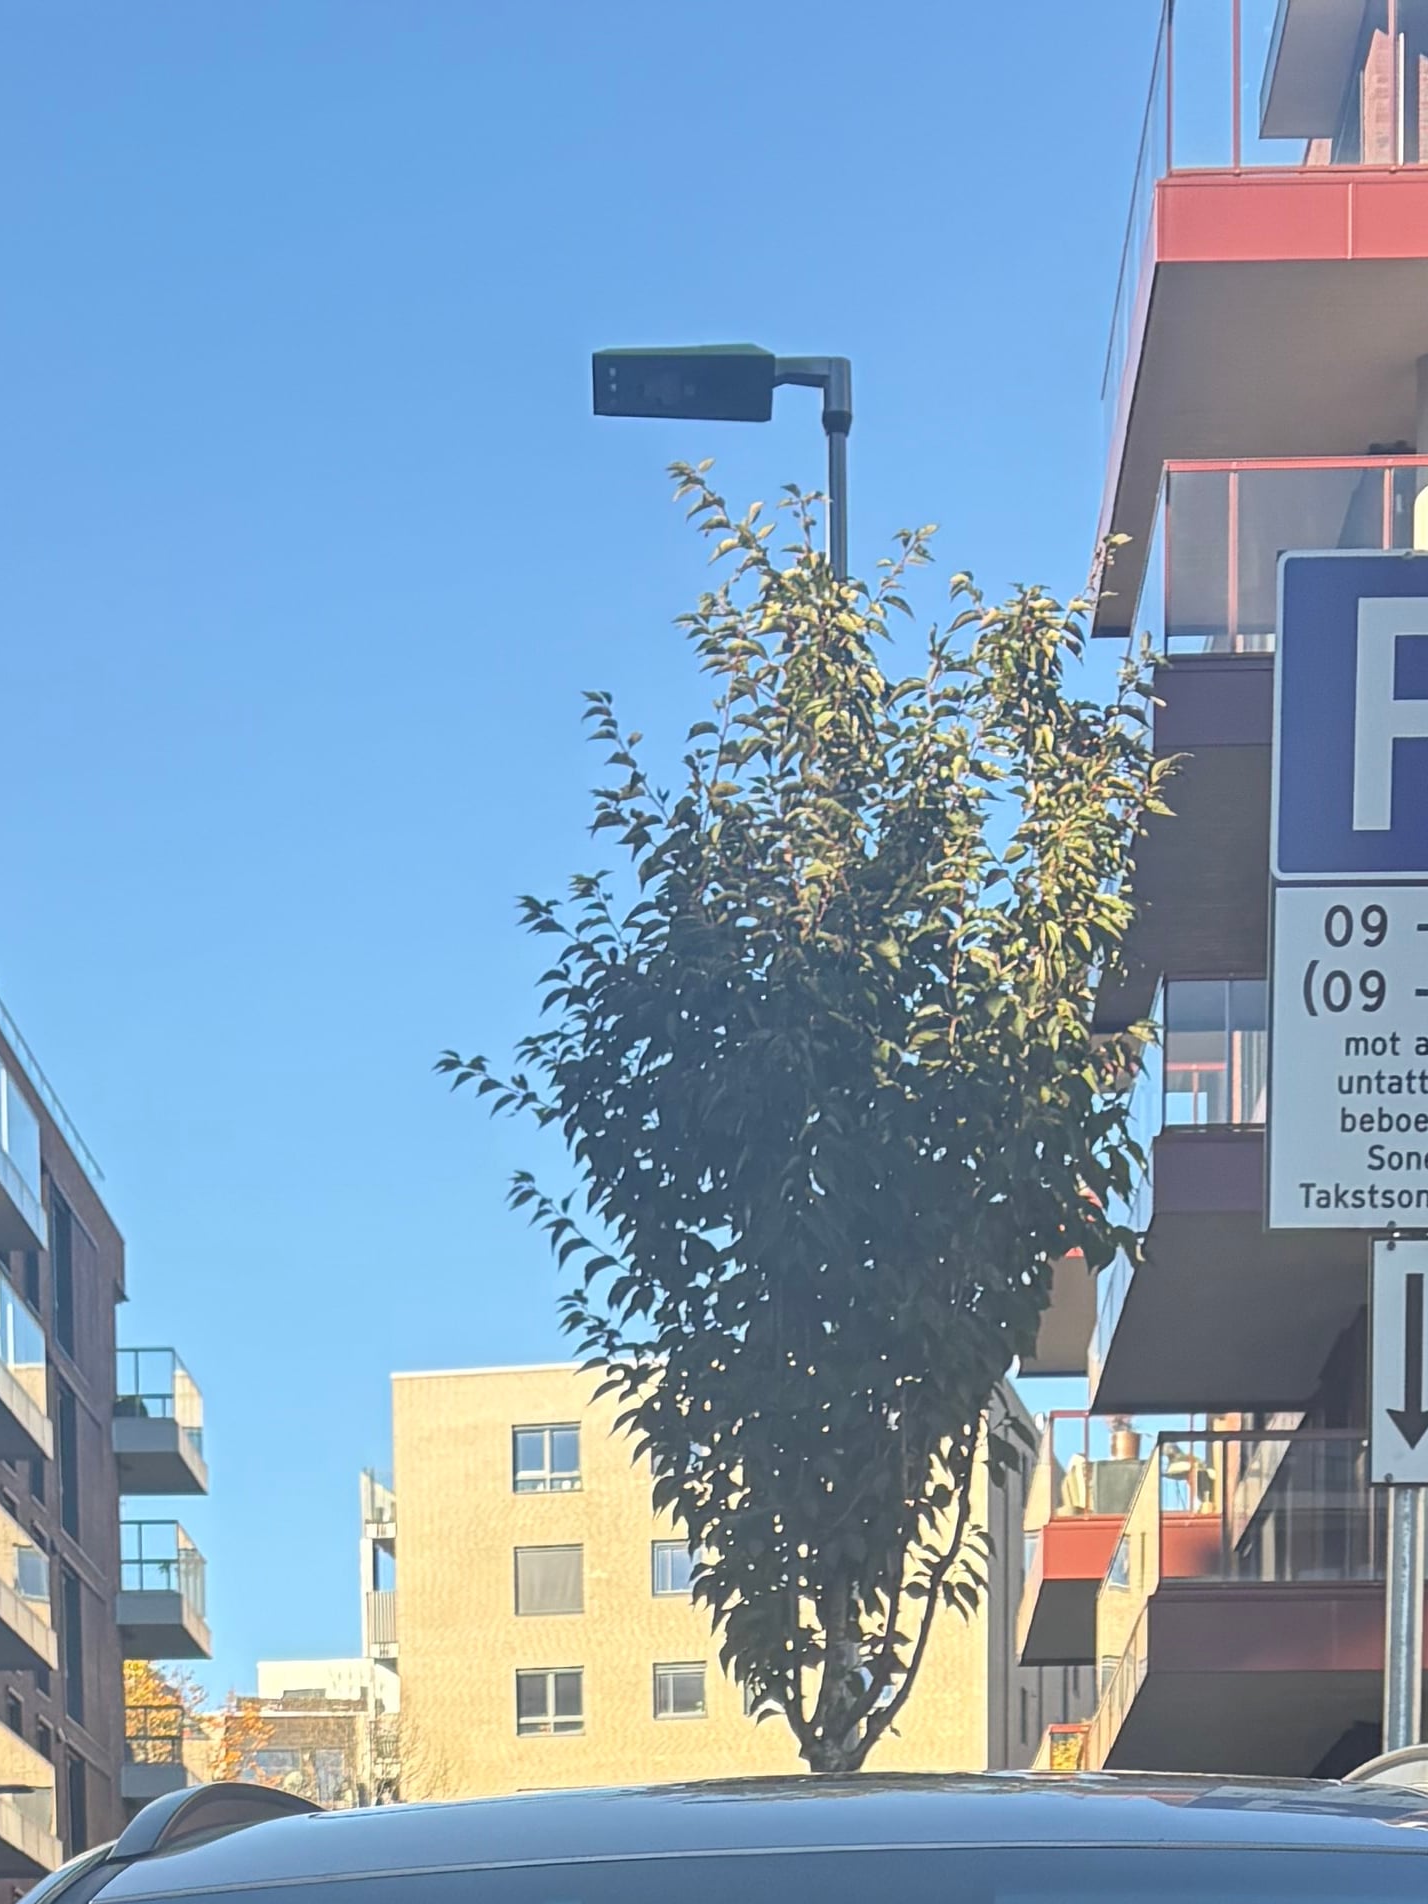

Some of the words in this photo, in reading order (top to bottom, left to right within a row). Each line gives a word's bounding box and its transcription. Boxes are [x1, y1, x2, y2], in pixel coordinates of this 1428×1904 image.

[1324, 903, 1389, 948] 09
[1302, 959, 1388, 1017] (09
[1344, 1031, 1401, 1057] mot
